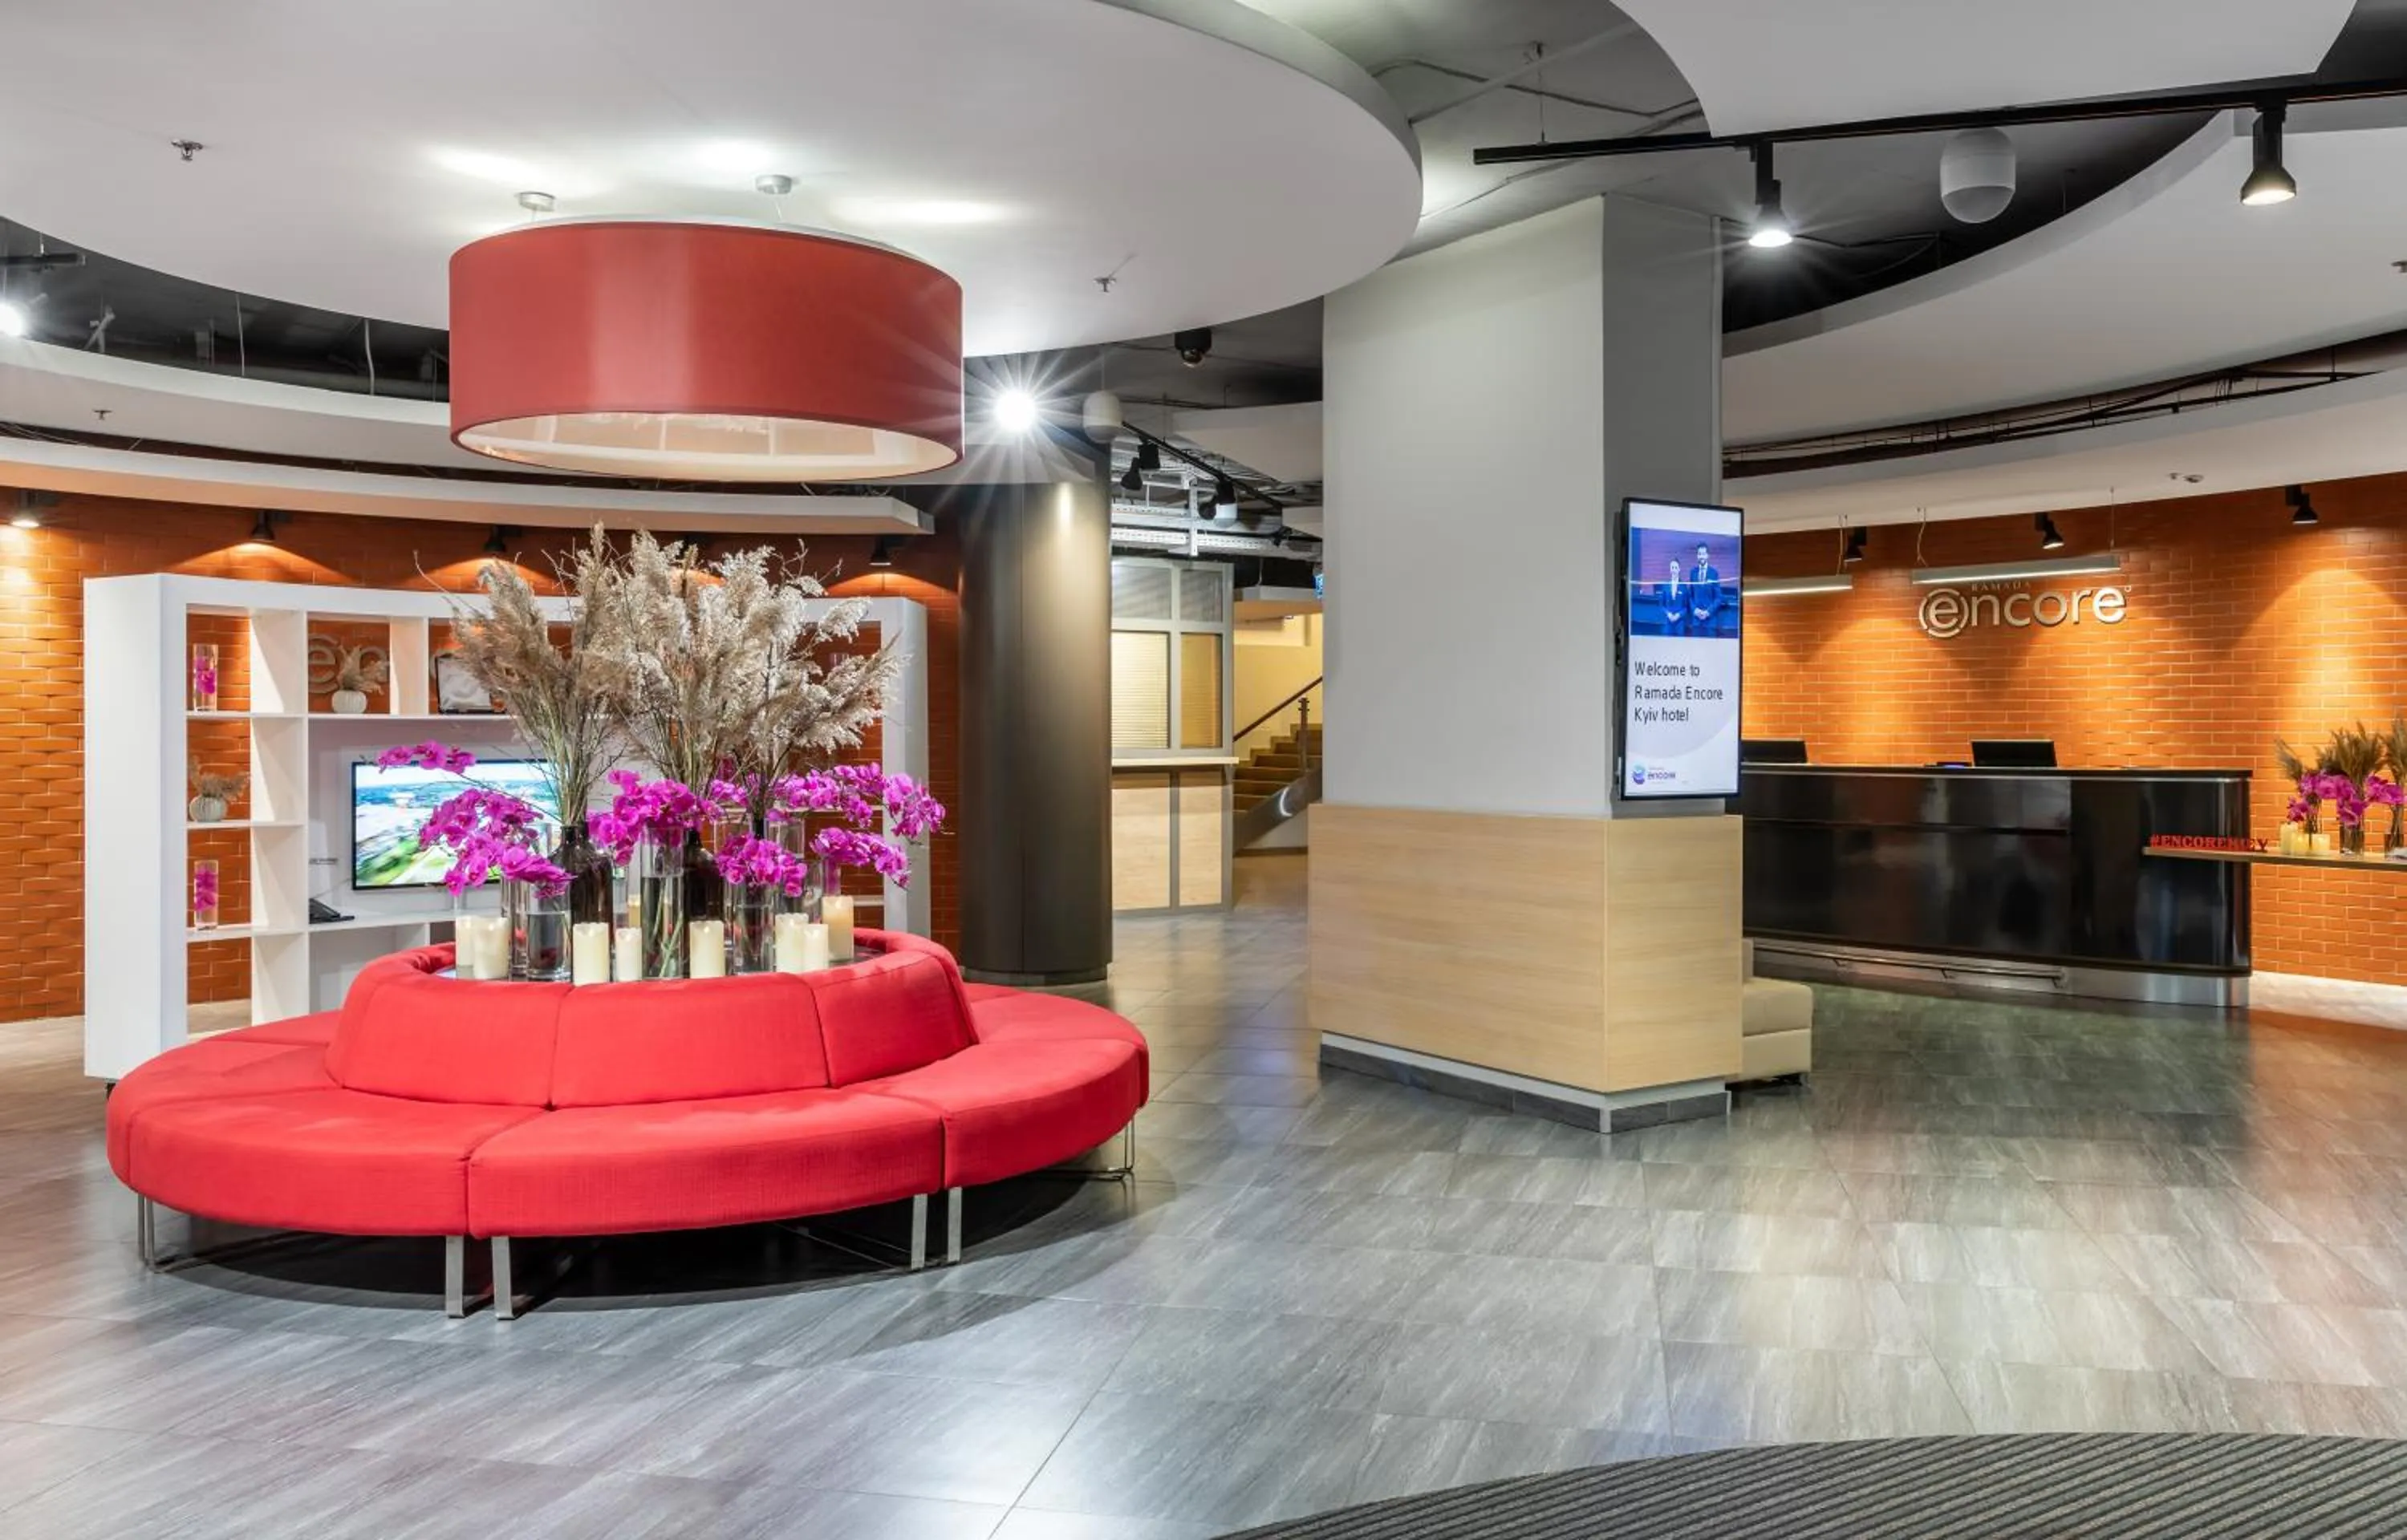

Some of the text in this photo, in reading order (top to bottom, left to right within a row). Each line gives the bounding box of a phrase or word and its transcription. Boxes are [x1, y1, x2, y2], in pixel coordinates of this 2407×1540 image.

[1918, 587, 2126, 638] encore
[1634, 661, 1700, 677] Welcome to
[1634, 685, 1723, 700] Ramada Encore
[1634, 707, 1689, 725] Kyiv hotel
